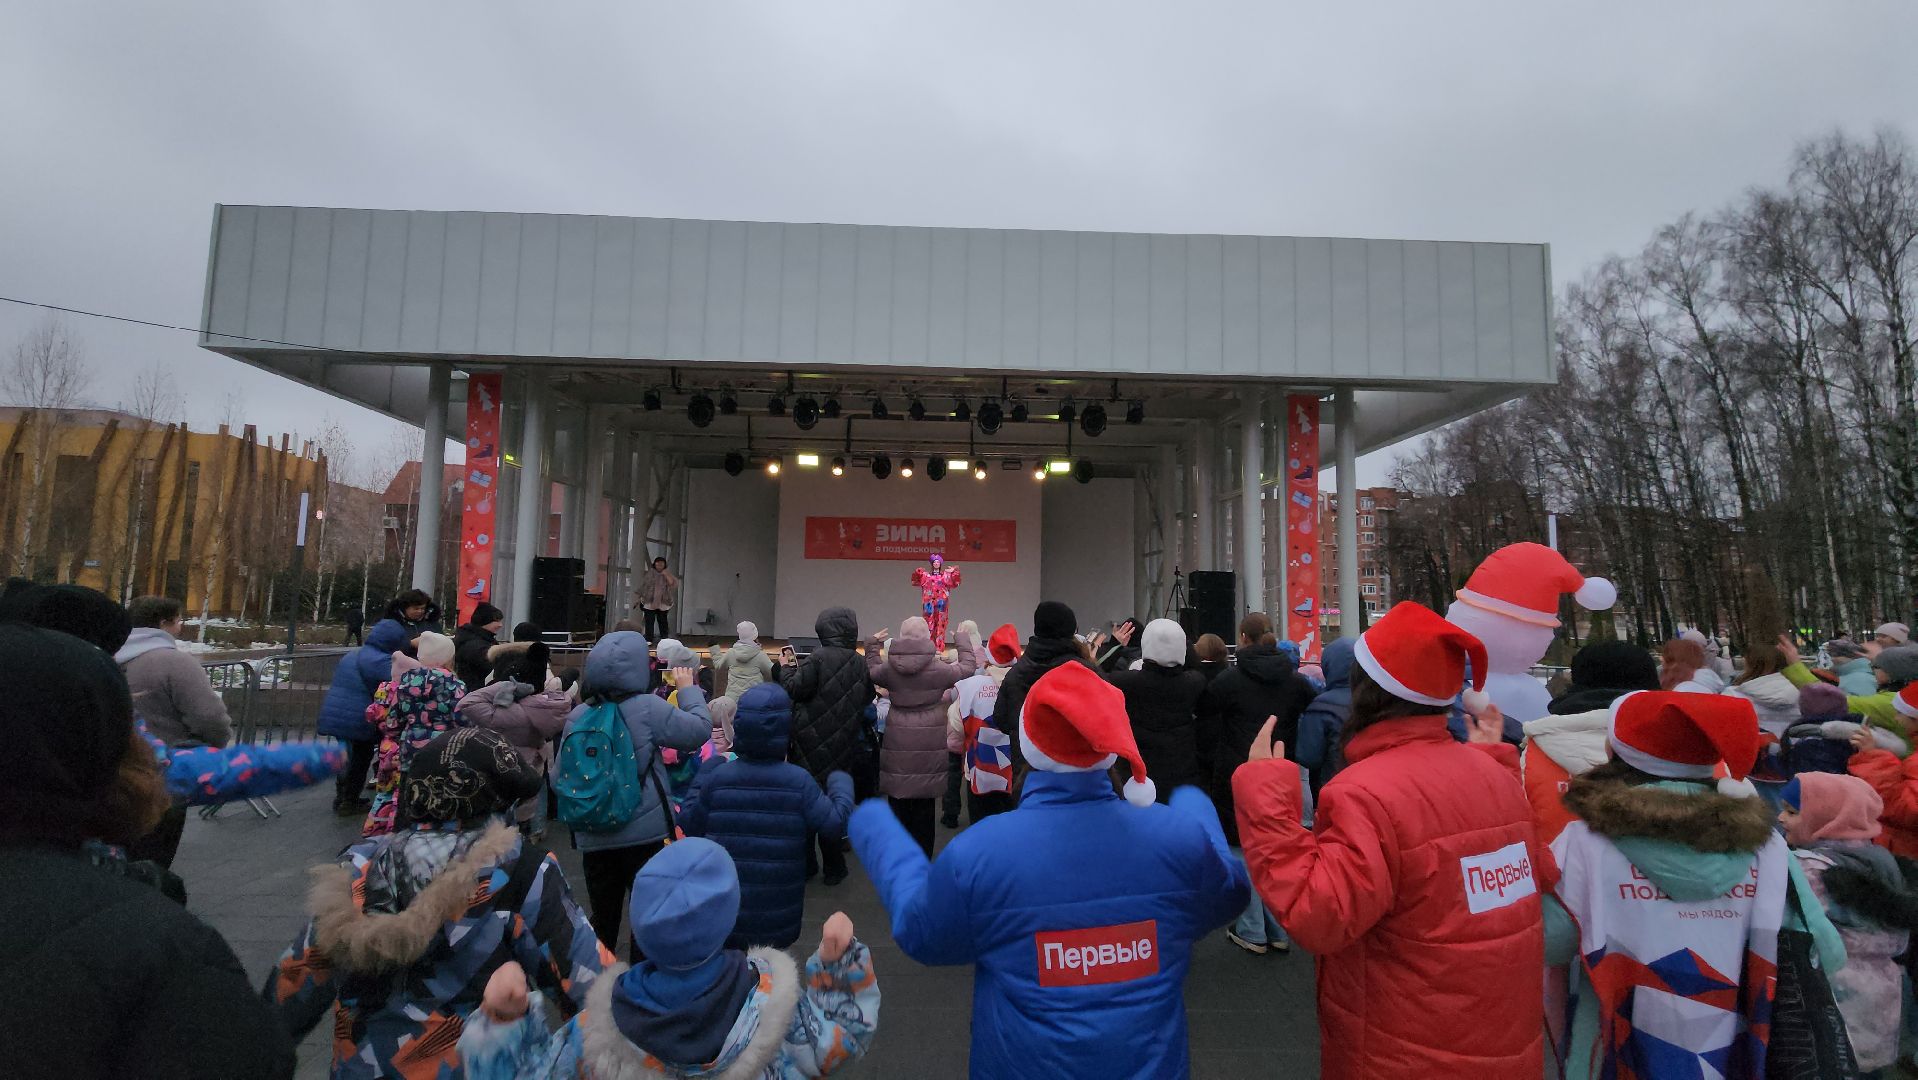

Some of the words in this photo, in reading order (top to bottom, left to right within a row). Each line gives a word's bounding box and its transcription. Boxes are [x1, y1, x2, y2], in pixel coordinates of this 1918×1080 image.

[876, 524, 946, 543] ЗИМА
[1467, 858, 1530, 897] Первые
[1043, 938, 1152, 976] Первые
